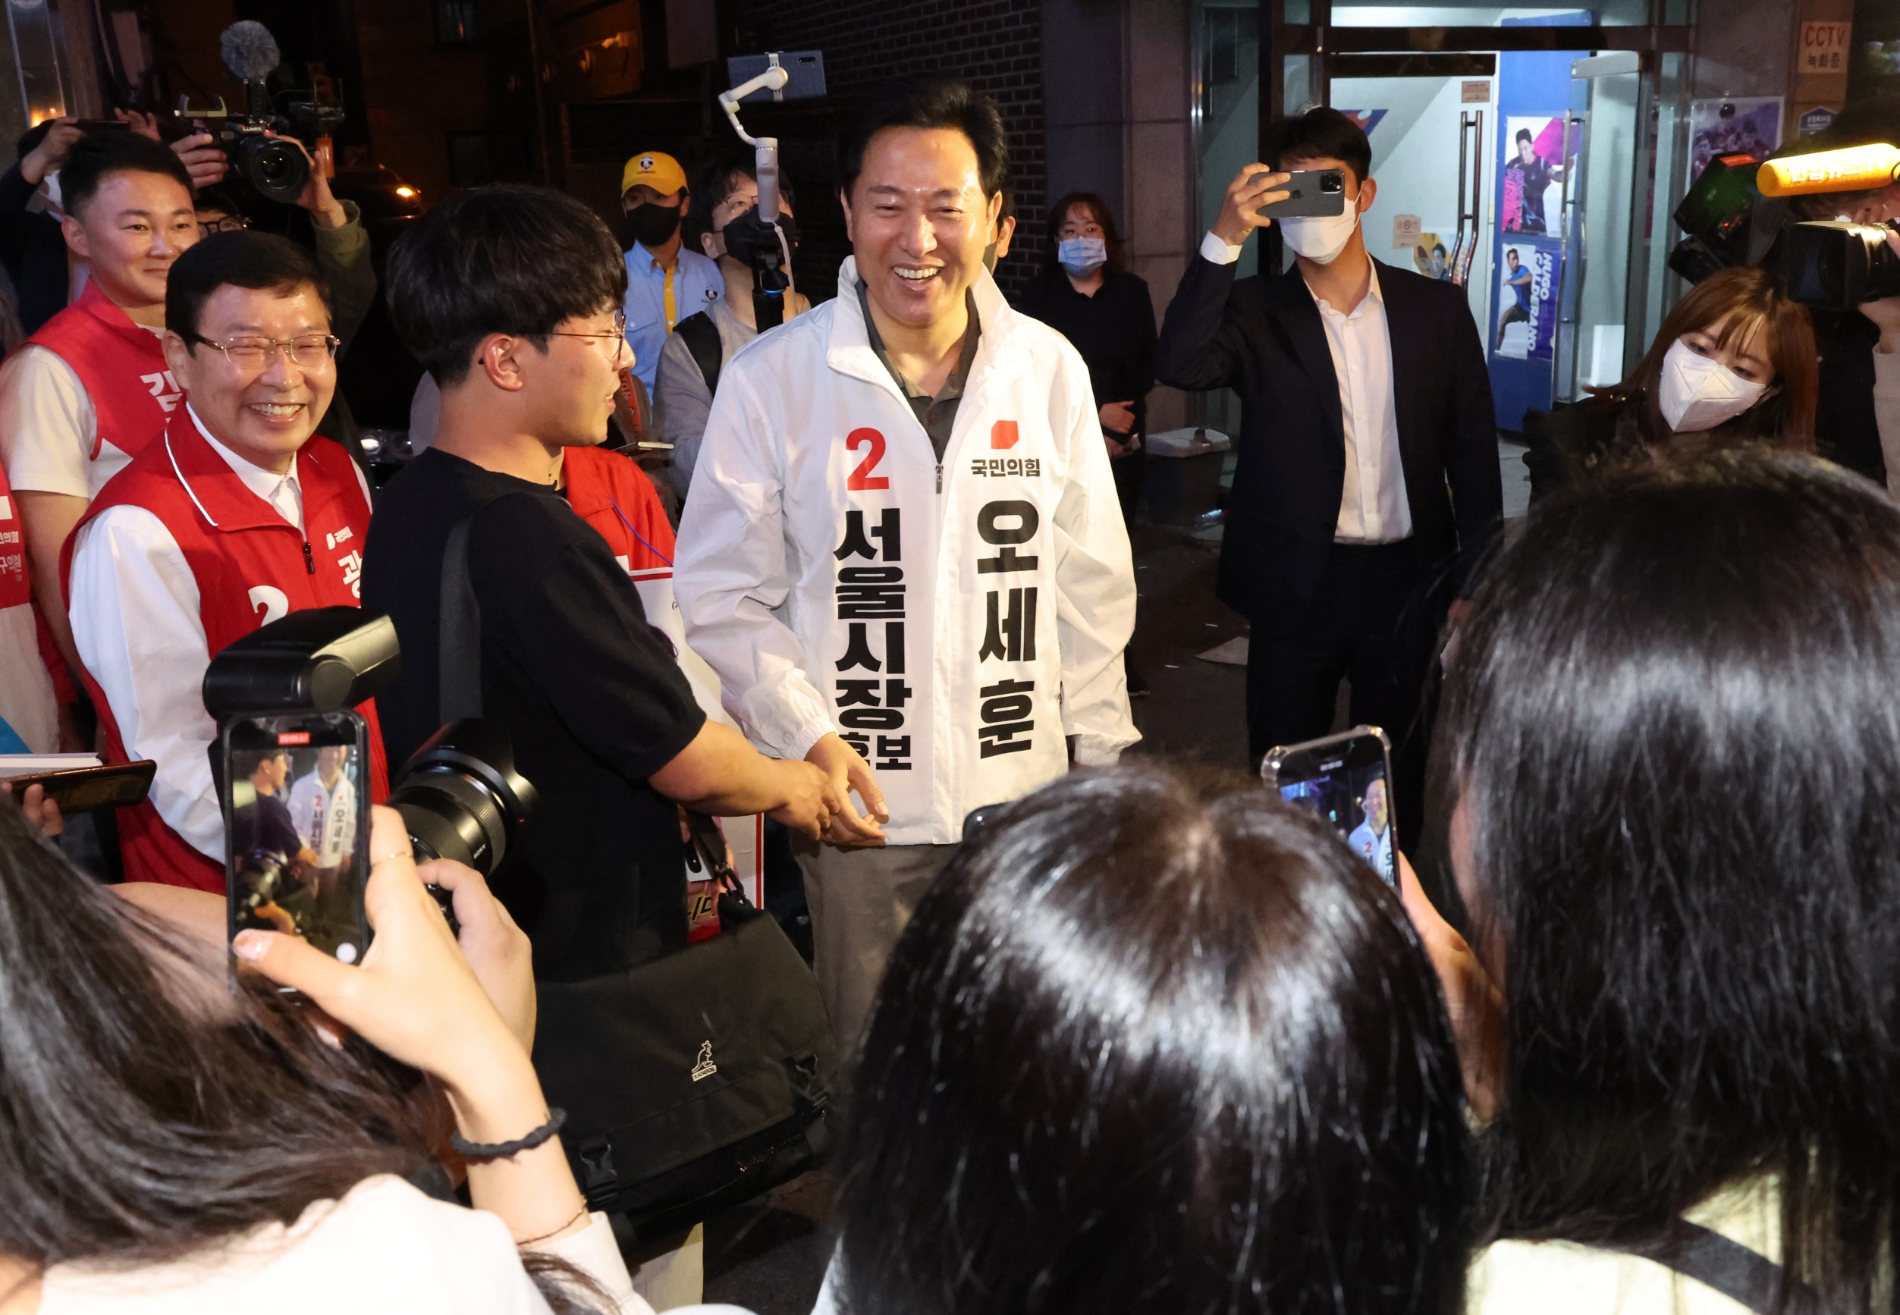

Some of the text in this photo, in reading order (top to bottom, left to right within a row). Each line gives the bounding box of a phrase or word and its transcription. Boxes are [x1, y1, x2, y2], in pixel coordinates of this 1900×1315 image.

[1805, 26, 1845, 47] CCTV
[1808, 52, 1840, 69] 녹화중
[1540, 252, 1553, 300] HUGO
[1528, 252, 1543, 352] CALDERANO
[845, 427, 890, 491] 2
[971, 459, 1041, 477] 국민의힘
[833, 508, 912, 731] 서울시장
[977, 500, 1040, 760] 오세훈
[1365, 841, 1373, 853] 2
